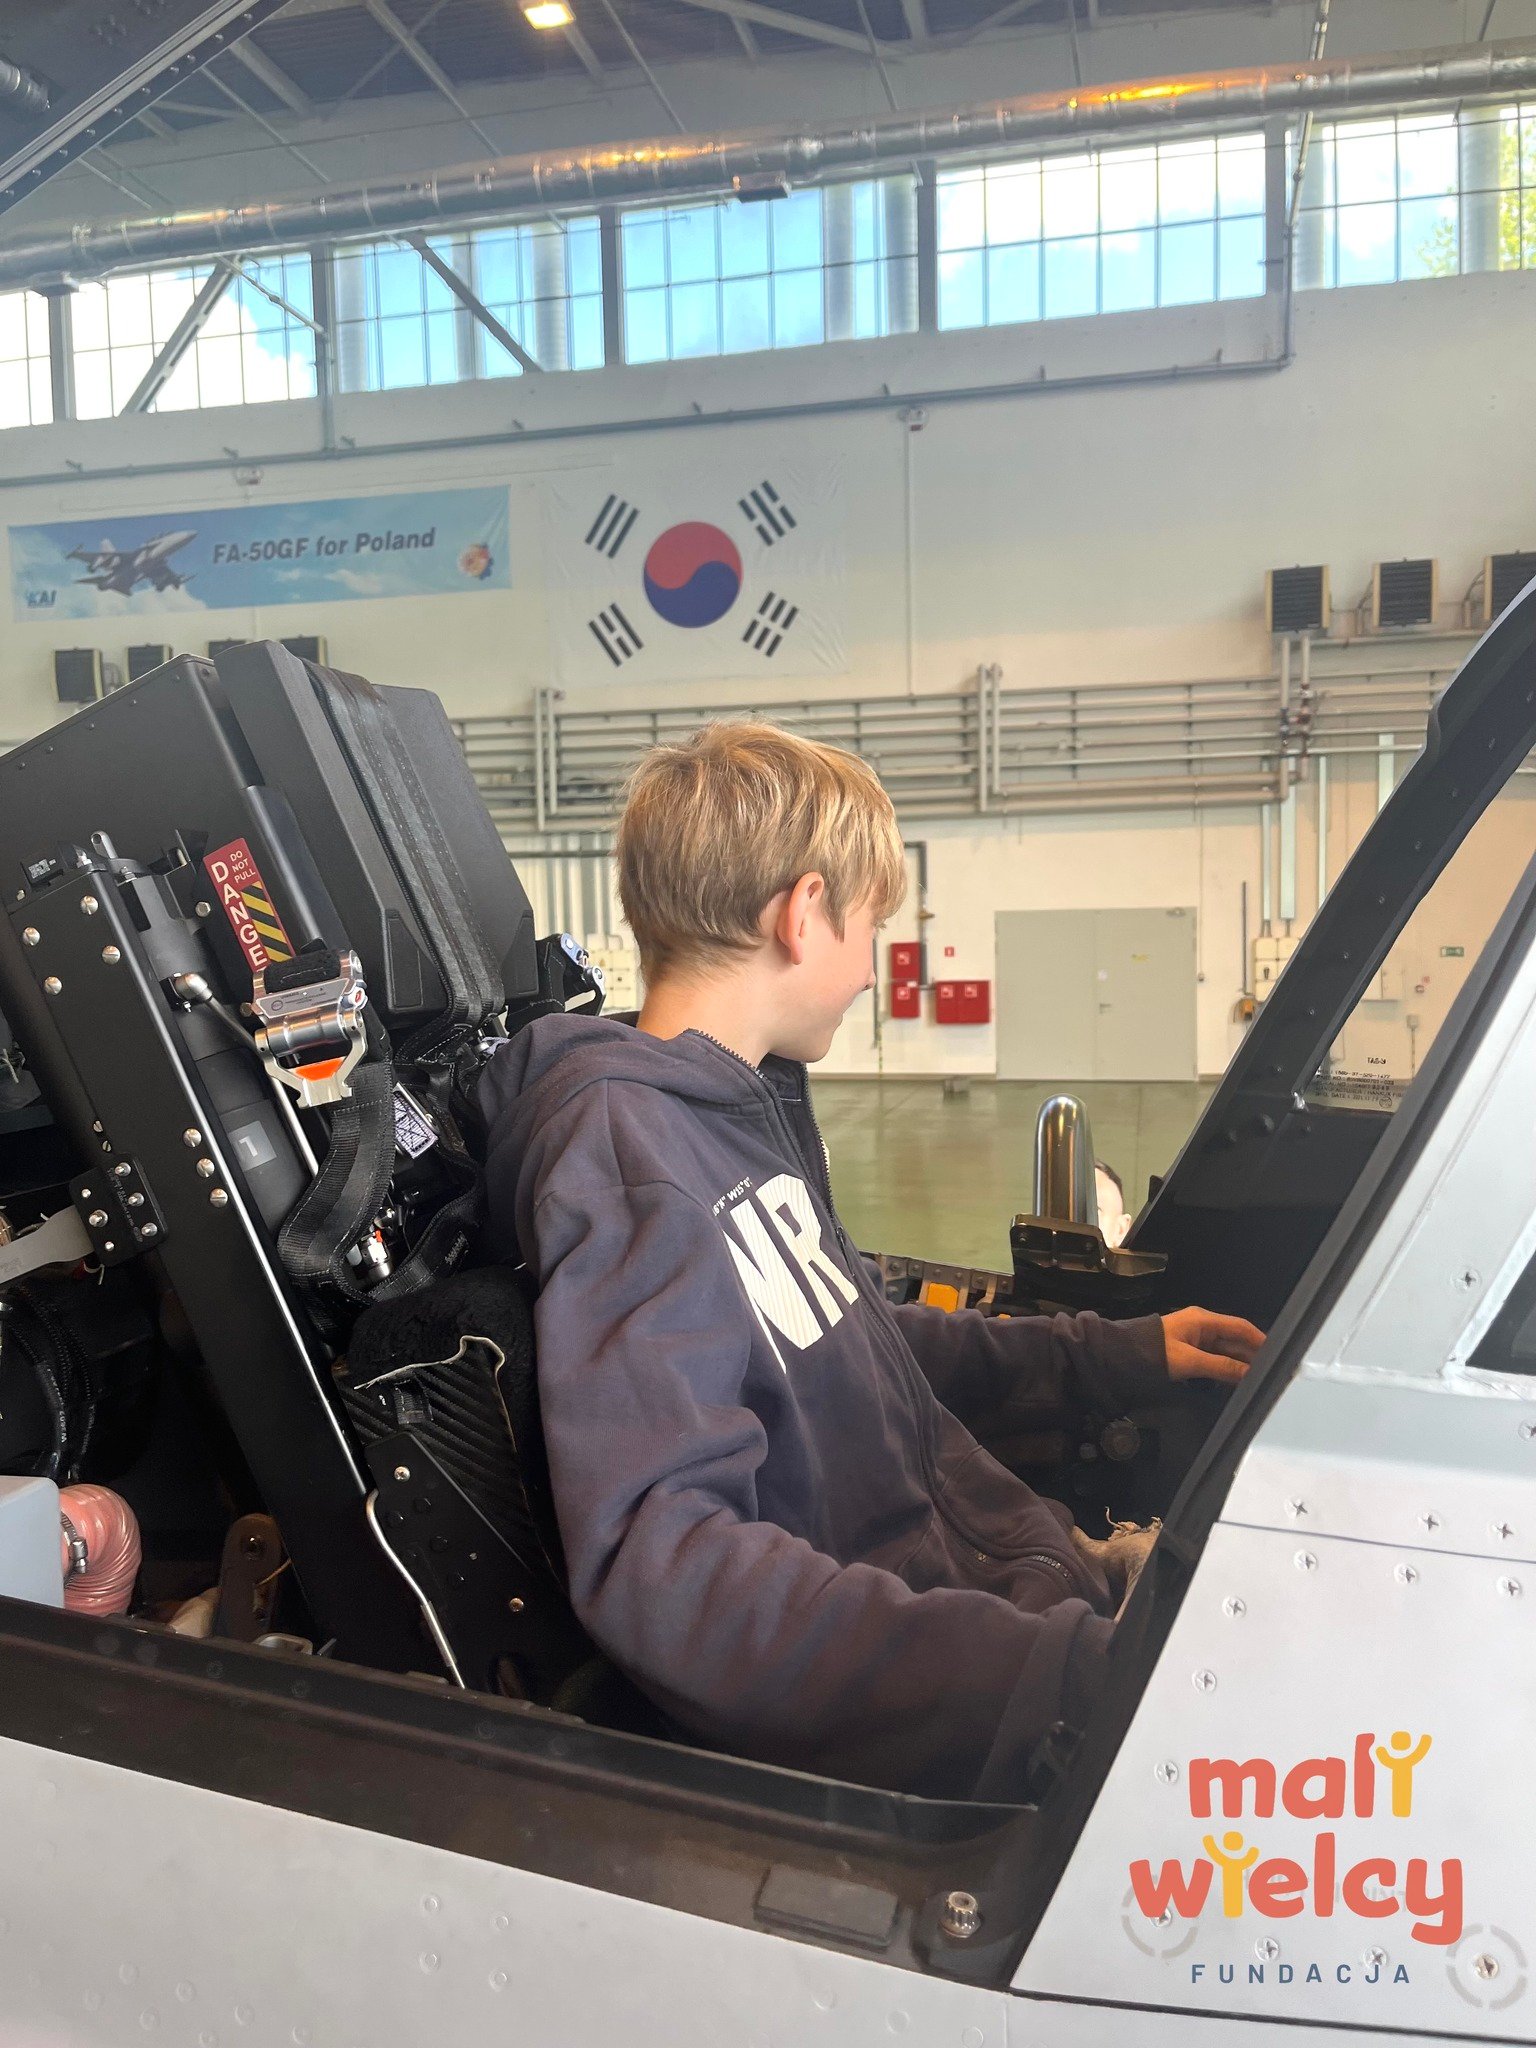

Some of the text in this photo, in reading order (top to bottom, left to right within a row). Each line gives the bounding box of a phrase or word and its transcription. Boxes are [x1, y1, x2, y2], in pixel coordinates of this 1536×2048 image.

[213, 526, 437, 564] FA-50GF for Poland
[230, 851, 243, 861] DO
[232, 858, 249, 872] NOT
[234, 868, 256, 883] PULL
[211, 861, 268, 972] DANGE
